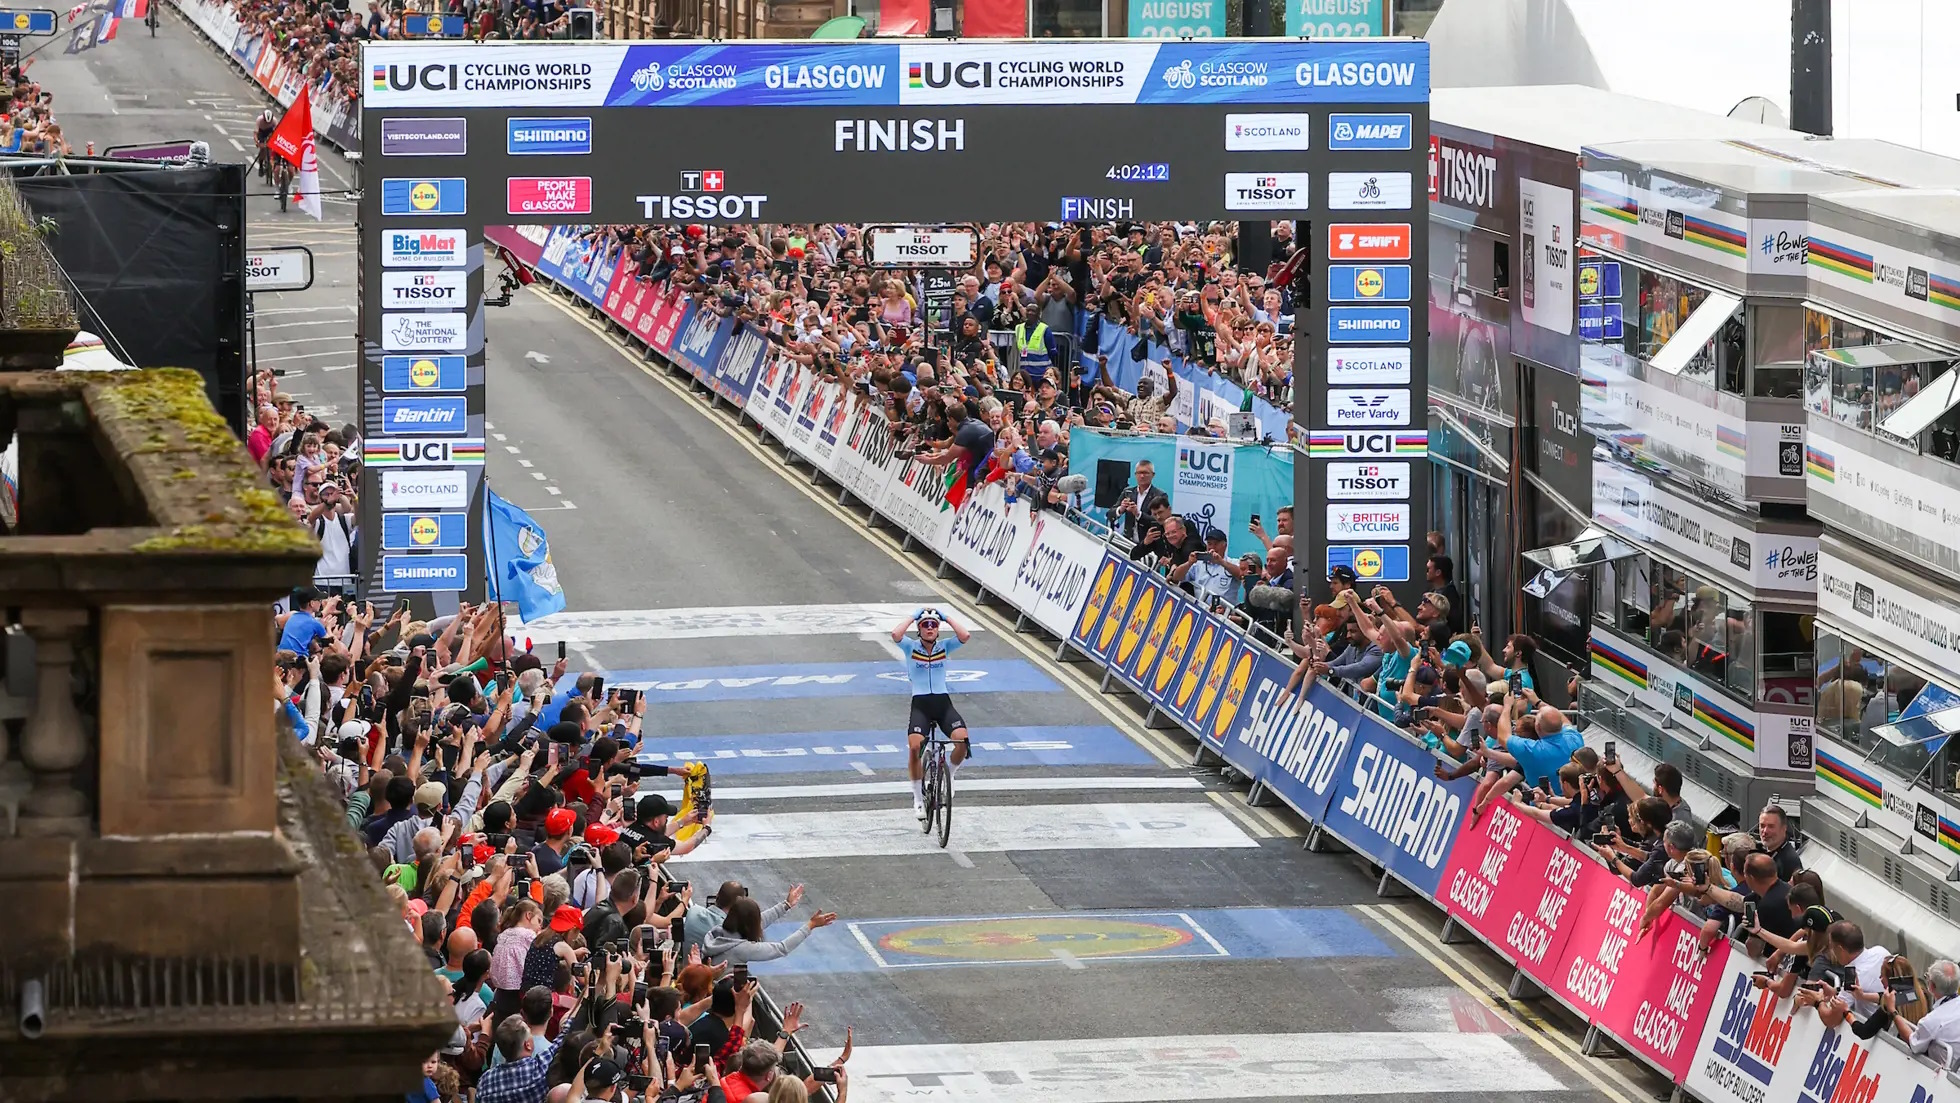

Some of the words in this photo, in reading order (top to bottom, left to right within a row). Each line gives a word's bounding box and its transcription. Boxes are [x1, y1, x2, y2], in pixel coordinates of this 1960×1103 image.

[1142, 2, 1213, 19] AUGUST
[1301, 0, 1371, 15] AUGUST
[464, 64, 530, 77] CYCLING
[535, 64, 592, 76] WORLD
[668, 64, 737, 77] GLASGOW
[764, 64, 887, 89] GLASGOW
[925, 62, 992, 88] UCI
[998, 62, 1064, 75] CYCLING
[1068, 62, 1124, 74] WORLD
[1200, 62, 1268, 74] GLASGOW
[1295, 62, 1416, 87] GLASGOW
[389, 64, 458, 91] UCI
[464, 77, 592, 91] CHAMPIONSHIPS
[668, 77, 737, 89] SCOTLAND
[998, 75, 1125, 88] CHAMPIONSHIPS
[1200, 75, 1268, 87] SCOTLAND
[387, 132, 461, 141] VISITSCOTLAND.COM
[514, 129, 587, 143] SHIMANO
[834, 118, 965, 151] FINISH
[1244, 127, 1301, 137] SCOTLAND
[1355, 124, 1405, 140] MAPEI
[1105, 164, 1167, 181] 4:02:12
[1441, 145, 1497, 209] TISSOT
[537, 180, 576, 191] PEOPLE
[1237, 188, 1296, 200] TISSOT
[545, 191, 576, 201] MAKE
[522, 200, 576, 211] GLASGOW
[636, 195, 768, 219] TISSOT
[1064, 199, 1135, 219] FINISH
[393, 234, 455, 255] BigMat
[896, 246, 948, 255] TISSOT
[1359, 236, 1401, 248] ZWIFT
[1761, 230, 1808, 255] #POWE
[1545, 244, 1567, 270] TISSOT
[1773, 254, 1785, 264] OF
[1786, 252, 1800, 263] THE
[245, 267, 280, 277] SSOT
[393, 287, 455, 298] TISSOT
[416, 328, 457, 336] NATIONAL
[1338, 319, 1401, 330] SHIMANO
[416, 336, 453, 344] LOTTERY
[1345, 361, 1403, 370] SCOTLAND
[393, 408, 456, 423] Santini
[1338, 409, 1366, 419] Peter
[1368, 409, 1400, 421] Vardy
[1785, 425, 1801, 434] UCI
[401, 442, 448, 461] UCI
[1346, 434, 1392, 453] UCI
[1542, 438, 1563, 462] CONNECT
[1189, 450, 1229, 473] UCI
[1179, 471, 1205, 480] CYCLING
[1206, 475, 1228, 483] WORLD
[1179, 478, 1228, 490] CHAMPIONSHIPS
[1338, 478, 1400, 489] TISSOT
[401, 485, 459, 494] SCOTLAND
[1353, 513, 1400, 522] BRITISH
[1642, 500, 1701, 545] #GLASGOWSCOTLAND2023
[958, 500, 1017, 567] SCOTLAND
[1353, 522, 1400, 532] CYCLING
[393, 567, 457, 578] SHIMANO
[1025, 542, 1087, 612] SCOTLAND
[1778, 570, 1789, 579] OF
[1791, 569, 1804, 578] THE
[1876, 595, 1947, 650] #GLASGOWSCOTLAND2023
[1794, 718, 1810, 727] UCI
[1238, 677, 1350, 796] SHIMANO
[637, 739, 1074, 763] SHMANO
[1340, 742, 1461, 869] SHIMANO
[747, 820, 1188, 840] SCOLAND
[1486, 806, 1522, 852] PEOPLE
[1478, 845, 1509, 887] MAKE
[1544, 846, 1583, 895] PEOPLE
[1450, 867, 1495, 920] GLASGOW
[1536, 887, 1568, 932] MAKE
[1604, 888, 1642, 938] PEOPLE
[1506, 911, 1553, 966] GLASGOW
[1596, 929, 1628, 975] MAKE
[1566, 955, 1615, 1012] GLASGOW
[1665, 973, 1698, 1021] MAKE
[1719, 972, 1792, 1068] BigMat
[1633, 1000, 1685, 1060] GLASGOW
[866, 1056, 1447, 1087] TISSOT
[1704, 1058, 1724, 1087] HOME
[1723, 1069, 1734, 1088] OF
